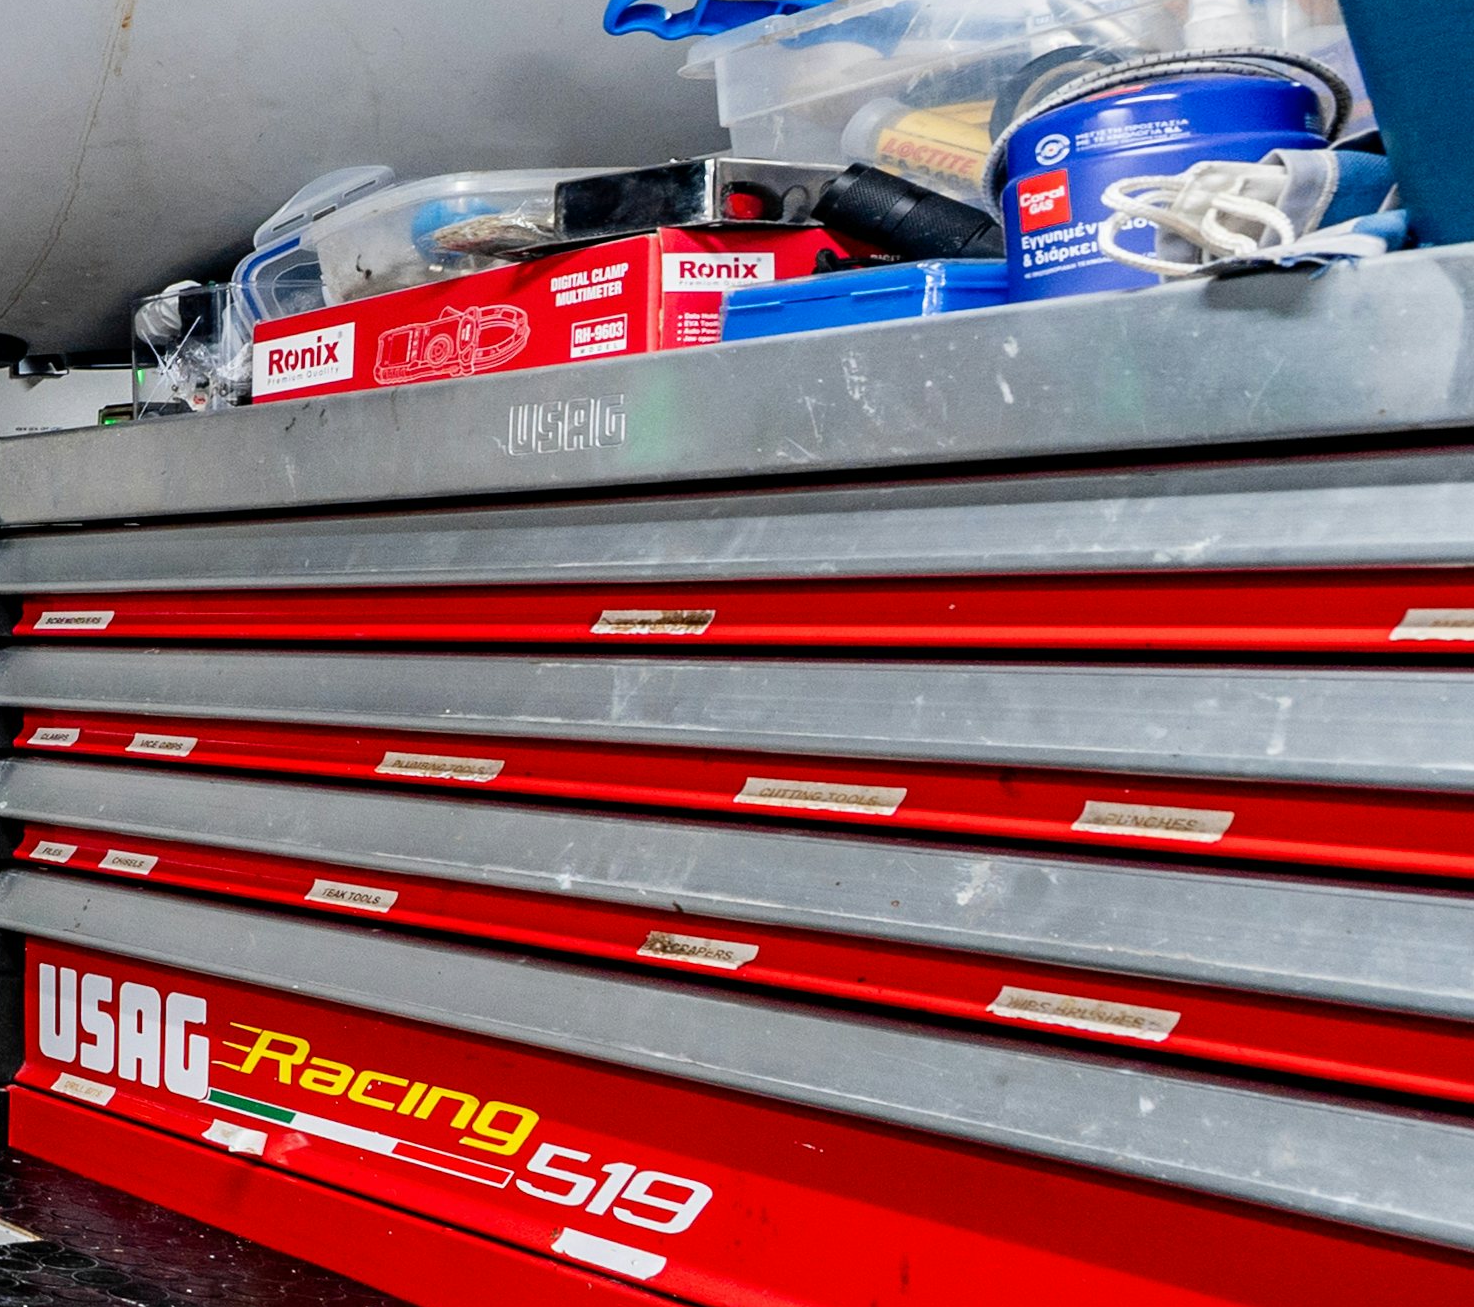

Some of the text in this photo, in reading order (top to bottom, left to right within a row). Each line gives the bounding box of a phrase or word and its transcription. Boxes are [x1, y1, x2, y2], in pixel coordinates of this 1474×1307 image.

[881, 138, 978, 174] LOCTITE
[1019, 185, 1066, 207] Coral
[1029, 199, 1054, 215] GAS
[550, 262, 629, 293] DIGITAL CLAMP
[679, 257, 758, 279] Ronix
[554, 280, 622, 308] MULTIMETER
[574, 320, 625, 344] RH-9603
[268, 335, 339, 376] Ronix
[507, 393, 626, 457] USAG
[45, 614, 101, 625] SCREWDRIVERS
[140, 739, 158, 748] VICE
[759, 787, 879, 805] CUTTING TOOLS
[111, 856, 145, 869] CHISELS
[322, 887, 382, 904] TEAK TOOLS
[38, 962, 714, 1234] USAG Racing 519
